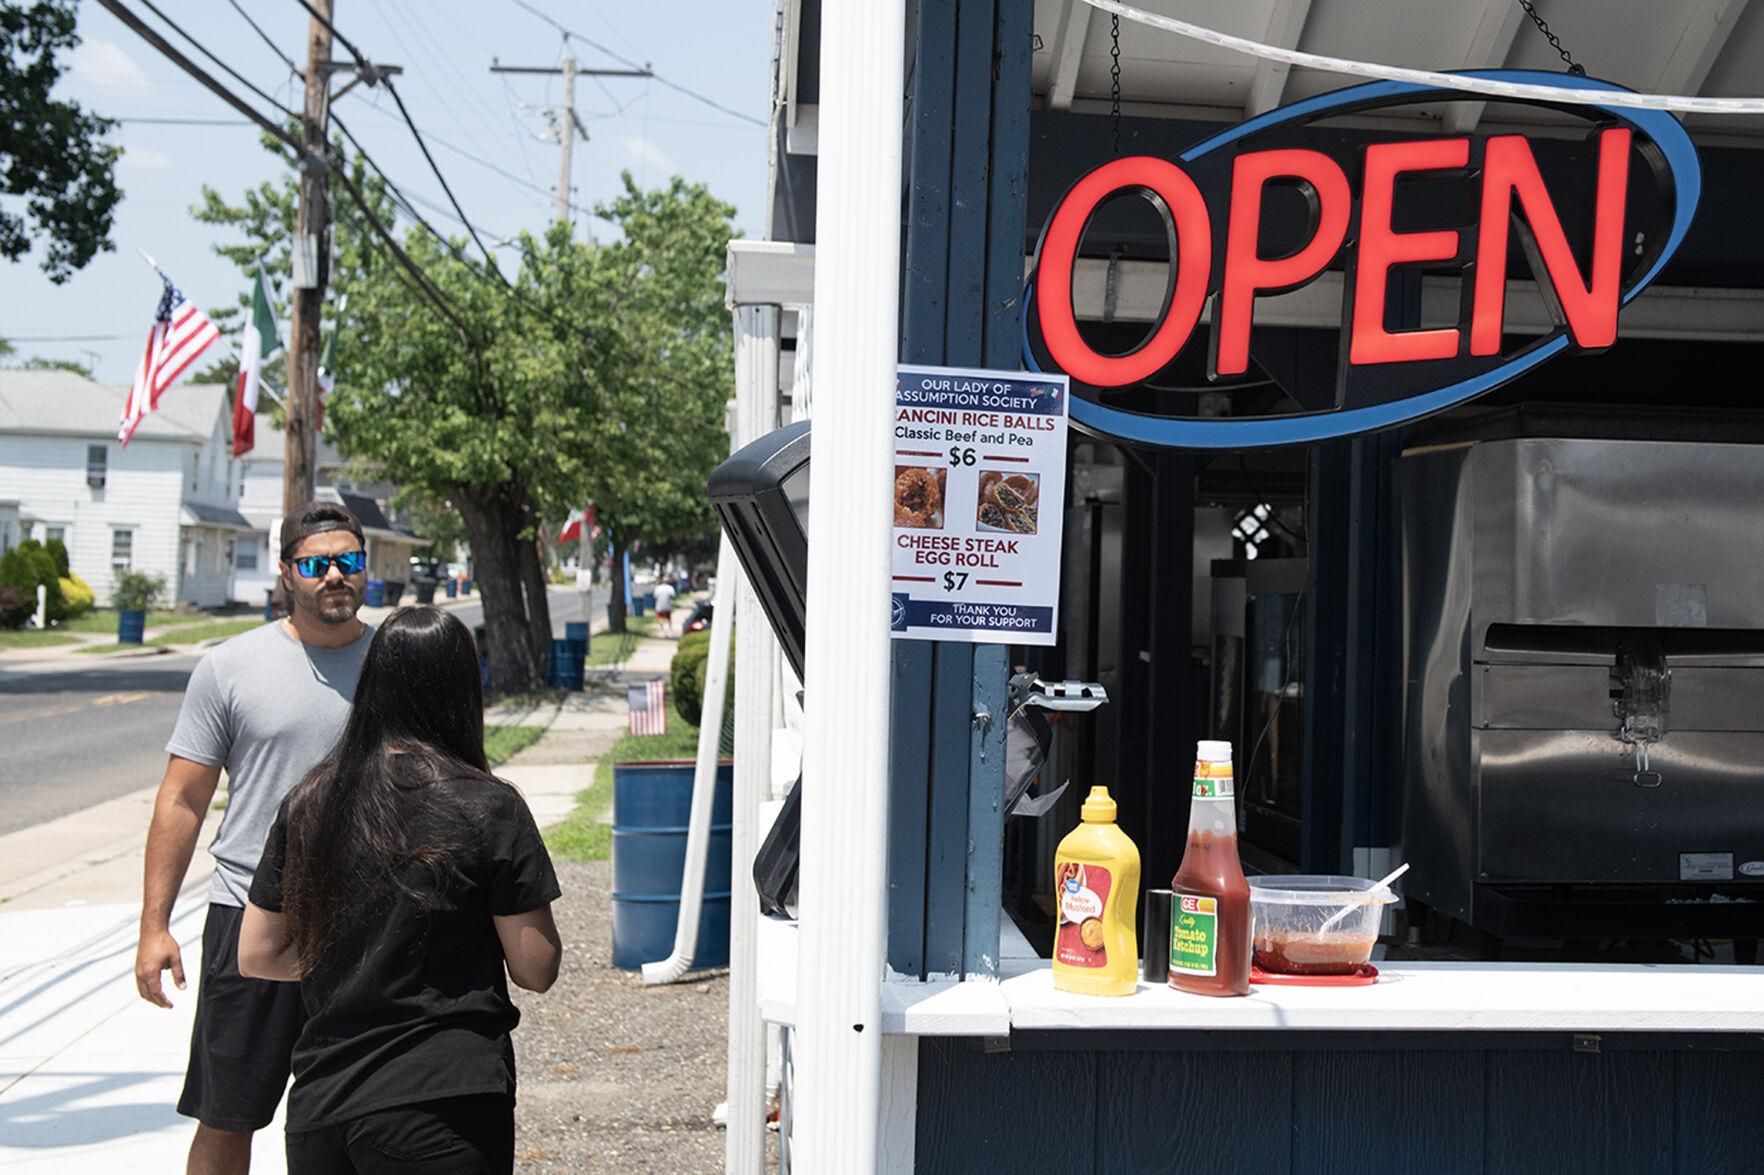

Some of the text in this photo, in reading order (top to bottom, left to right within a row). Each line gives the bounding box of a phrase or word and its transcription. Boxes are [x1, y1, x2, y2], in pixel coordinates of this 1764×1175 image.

[1037, 127, 1632, 388] OPEN
[922, 379, 1012, 395] OUR LADY OF
[896, 390, 1038, 409] ASSUMPTION SOCIETY
[896, 408, 1055, 431] ANCINI RICE BALLS
[895, 426, 1033, 446] Classic Beef and Pea
[949, 445, 977, 467] $6
[897, 534, 1019, 554] CHEESE STEAK
[915, 551, 999, 568] EGG ROLL
[943, 571, 969, 592] $7
[953, 603, 1017, 616] THANK YOU
[930, 613, 1037, 628] FOR YOUR SUPPORT
[1174, 926, 1206, 942] Tomato
[1173, 938, 1208, 957] Ketchup
